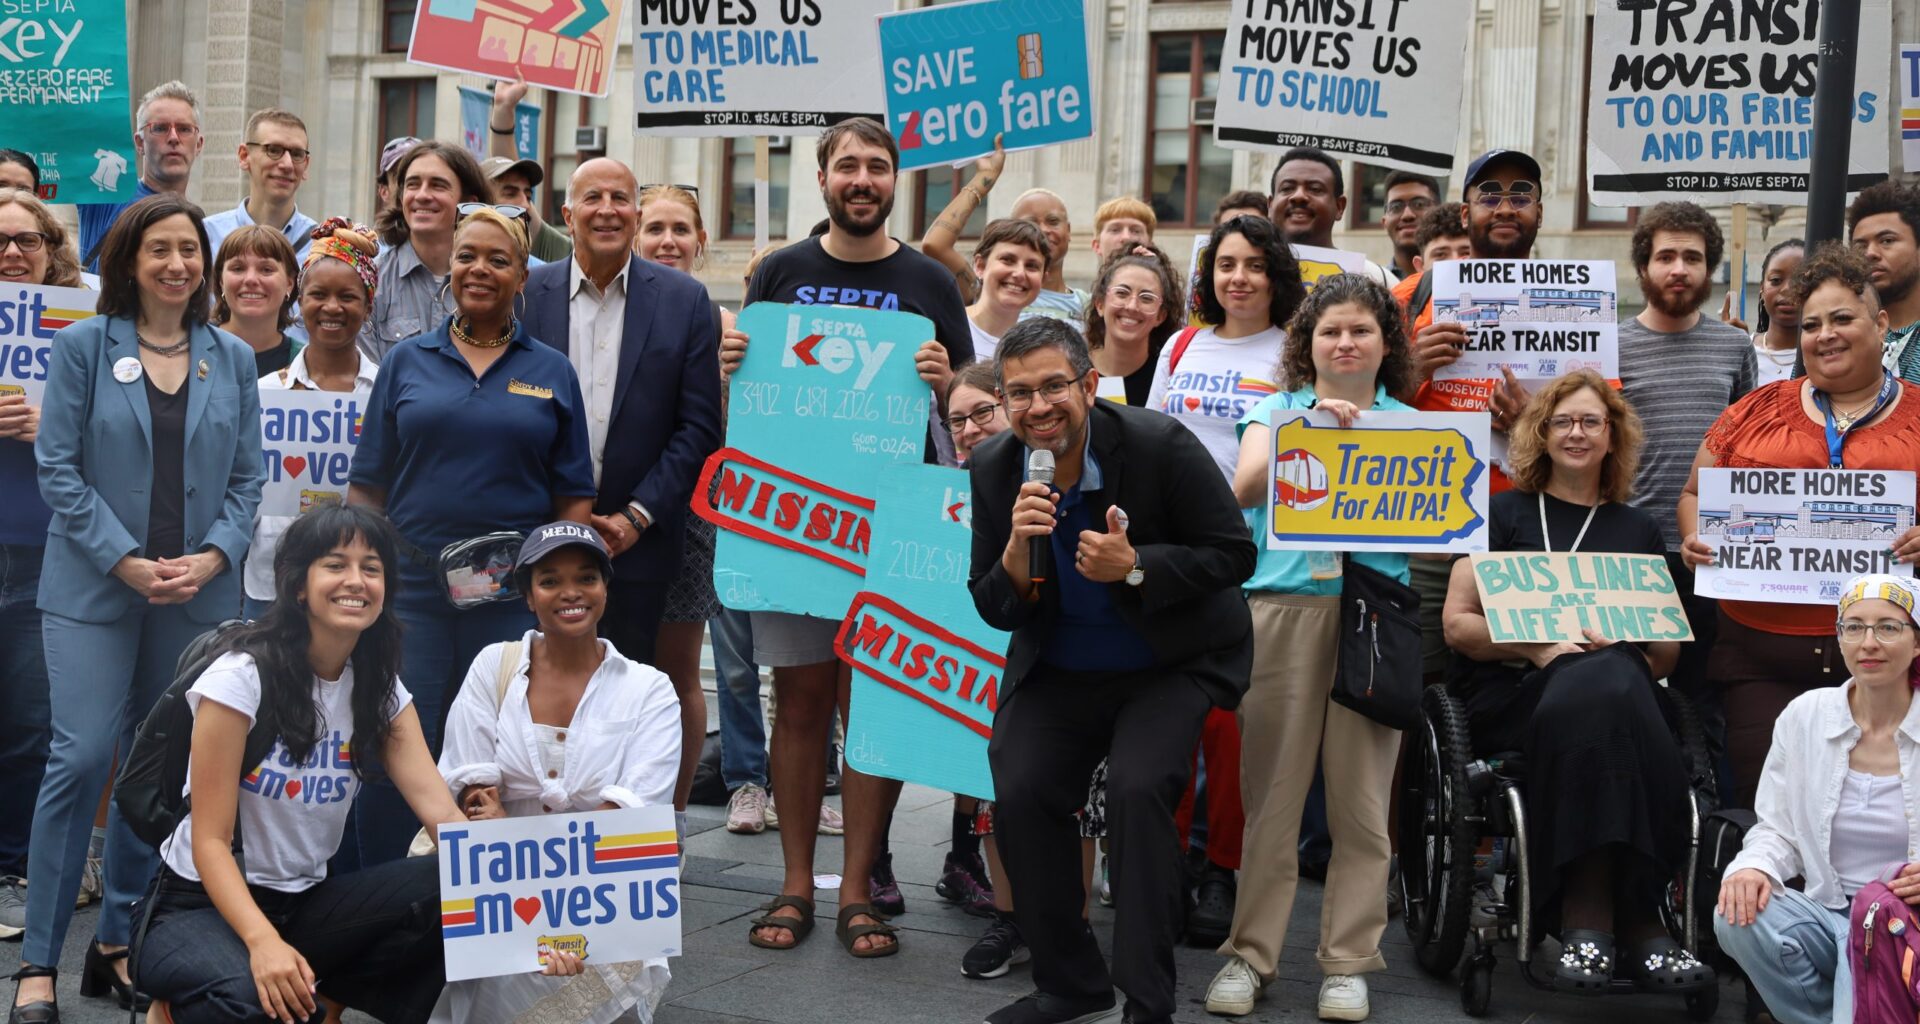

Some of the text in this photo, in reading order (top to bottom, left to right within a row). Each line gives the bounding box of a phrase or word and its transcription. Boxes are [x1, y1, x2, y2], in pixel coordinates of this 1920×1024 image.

[2, 0, 76, 14] SEPTA
[640, 0, 822, 26] MOVES US
[640, 29, 819, 67] TO MEDICAL
[1239, 24, 1422, 78] MOVES US
[14, 69, 64, 87] ZERO
[65, 68, 114, 86] FARE
[892, 46, 977, 95] SAVE
[1608, 52, 1819, 98] MOVES US
[0, 86, 104, 105] PERMANENT
[643, 68, 726, 104] CARE
[1232, 65, 1389, 119] TO SCHOOL
[704, 111, 827, 125] STOP I.D. #SAVE SEPTA
[898, 79, 1080, 151] zero fare
[1605, 91, 1878, 129] TO OUR FRIES
[518, 114, 530, 153] Park
[1277, 133, 1390, 157] STOP I.D. #SAVE SEPTA
[1641, 130, 1705, 163] AND
[40, 152, 58, 167] THE
[1666, 176, 1806, 189] STOP I.D. #SAVE SEPTA
[1459, 262, 1590, 285] MORE HOMES
[793, 285, 899, 311] SEPTA
[810, 318, 867, 338] SEPTA
[1512, 330, 1600, 352] TRANSIT
[781, 313, 896, 391] key
[1431, 380, 1493, 398] ROOSEVEL
[736, 381, 783, 416] 3402
[832, 389, 880, 420] 2026
[886, 394, 927, 426] 1264
[1450, 397, 1489, 411] SUBW
[1337, 444, 1457, 488] Transit
[1730, 470, 1887, 497] MORE HOMES
[1331, 491, 1451, 522] For All PA!
[541, 525, 596, 543] MEDIA
[1719, 545, 1893, 574] NEAR TRANSIT
[1475, 556, 1677, 596] BUS LINES
[1550, 592, 1597, 608] ARE
[1819, 586, 1841, 596] AIR
[1487, 606, 1691, 641] LIFE LINES
[439, 820, 602, 887] Transit
[628, 877, 679, 921] us
[552, 938, 582, 950] Transit
